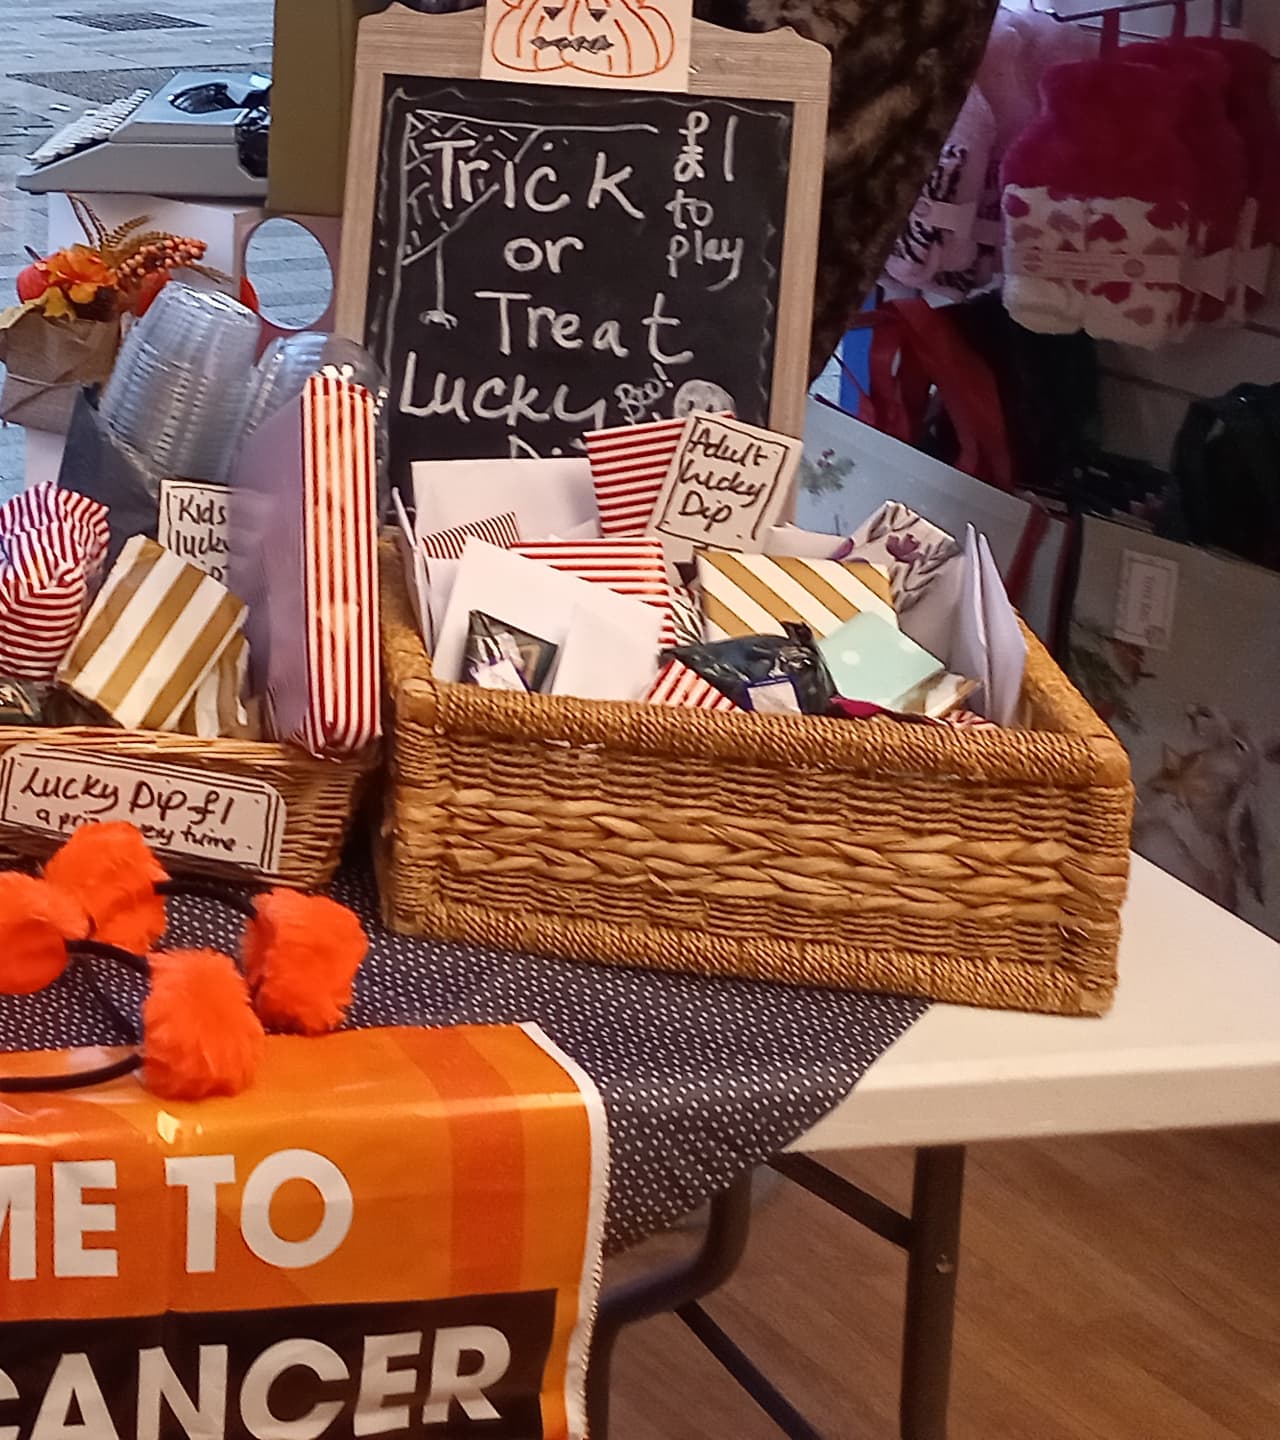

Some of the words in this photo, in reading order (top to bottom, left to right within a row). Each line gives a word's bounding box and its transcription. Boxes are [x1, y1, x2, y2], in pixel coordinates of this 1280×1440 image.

[422, 137, 646, 220] Trick
[664, 187, 714, 229] to
[503, 231, 585, 275] or
[666, 235, 745, 292] play
[474, 290, 696, 365] Treat
[398, 350, 607, 430] Lucky
[690, 428, 768, 467] Adult
[179, 494, 227, 526] Kids
[678, 490, 733, 533] Dip
[20, 767, 119, 814] Lucky
[129, 779, 188, 822] Dip
[36, 809, 51, 825] a
[165, 1148, 354, 1274] TO
